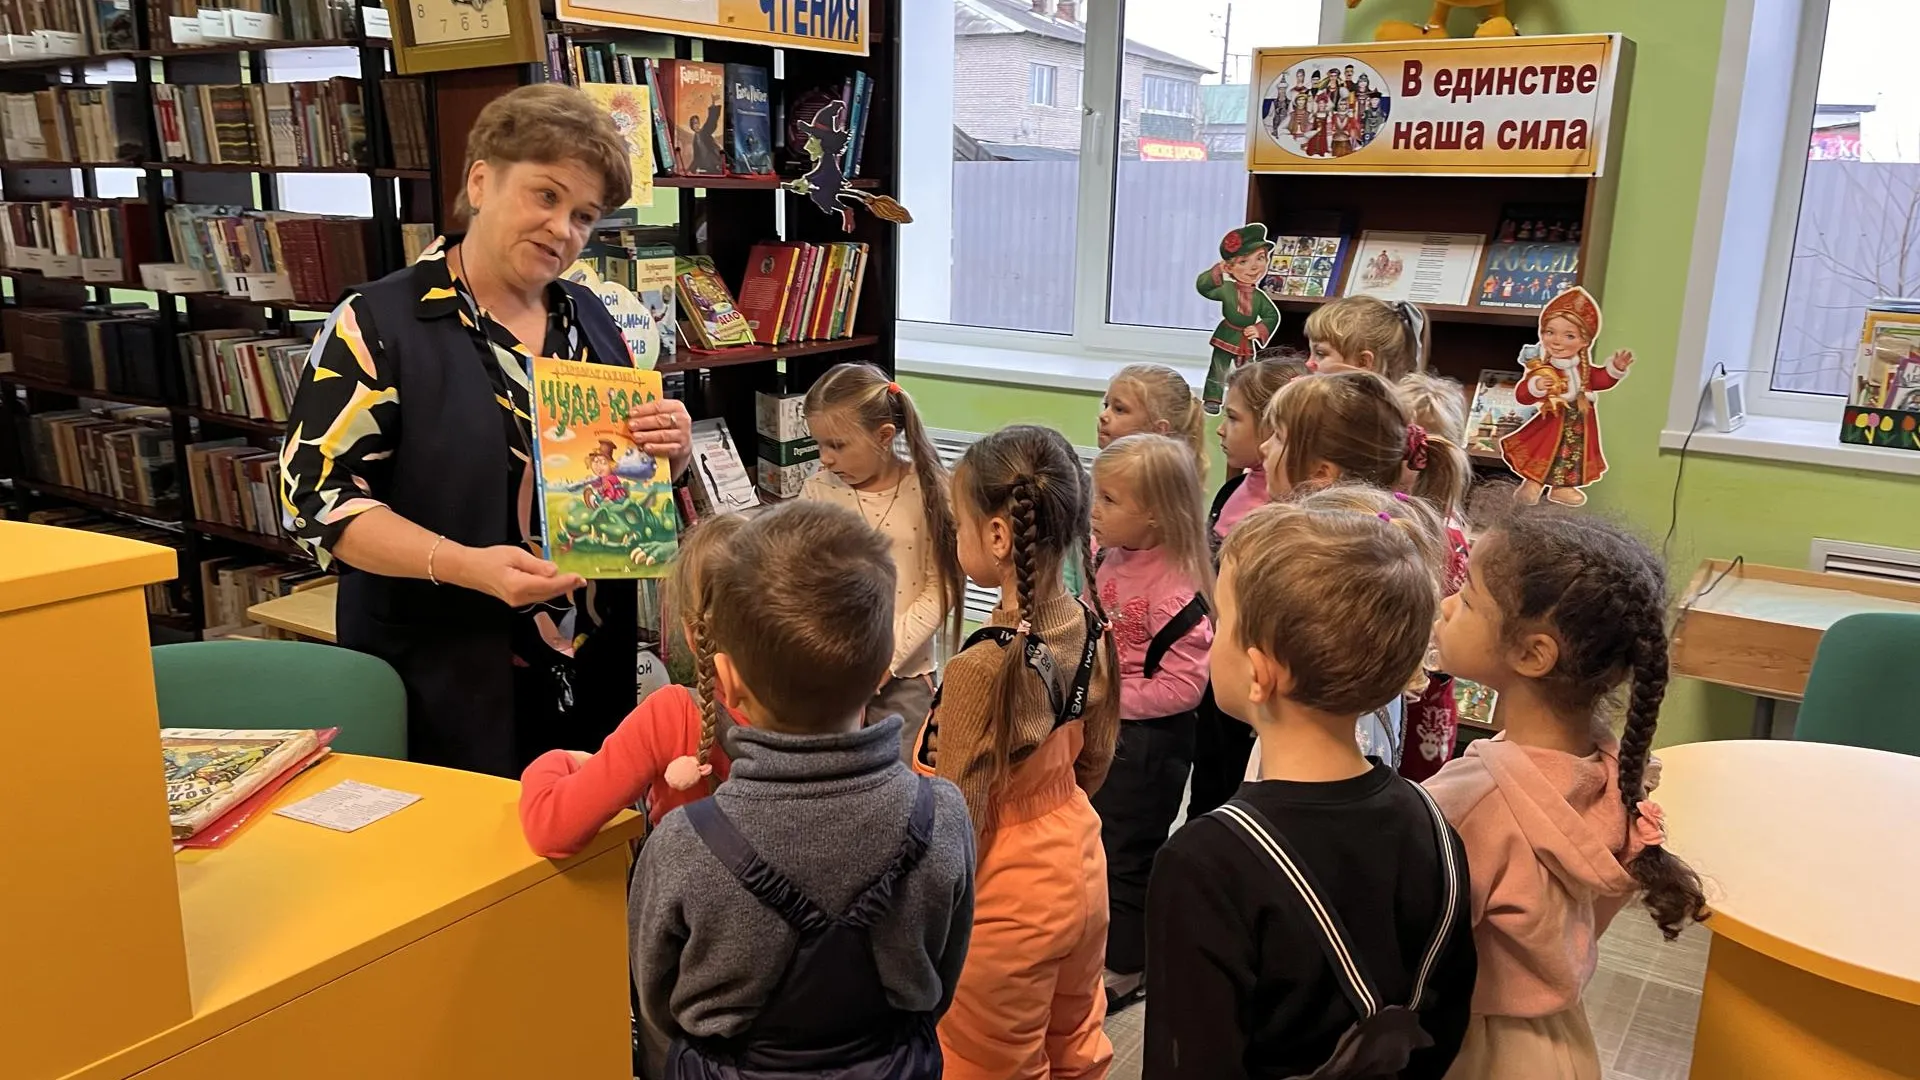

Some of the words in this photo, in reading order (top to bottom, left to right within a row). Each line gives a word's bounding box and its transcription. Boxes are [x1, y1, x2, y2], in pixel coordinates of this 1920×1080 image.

[417, 4, 426, 19] 8
[439, 19, 448, 34] 7
[461, 16, 470, 31] 6
[481, 14, 489, 29] 5
[760, 0, 859, 43] ЧТЕНИЯ
[1401, 60, 1423, 97] В
[1434, 64, 1597, 103] единстве
[1393, 121, 1485, 150] наша
[1497, 119, 1588, 150] сила
[600, 290, 619, 306] ОЙ
[540, 379, 656, 438] ЧУДО-Ю
[637, 659, 653, 675] ОЙ
